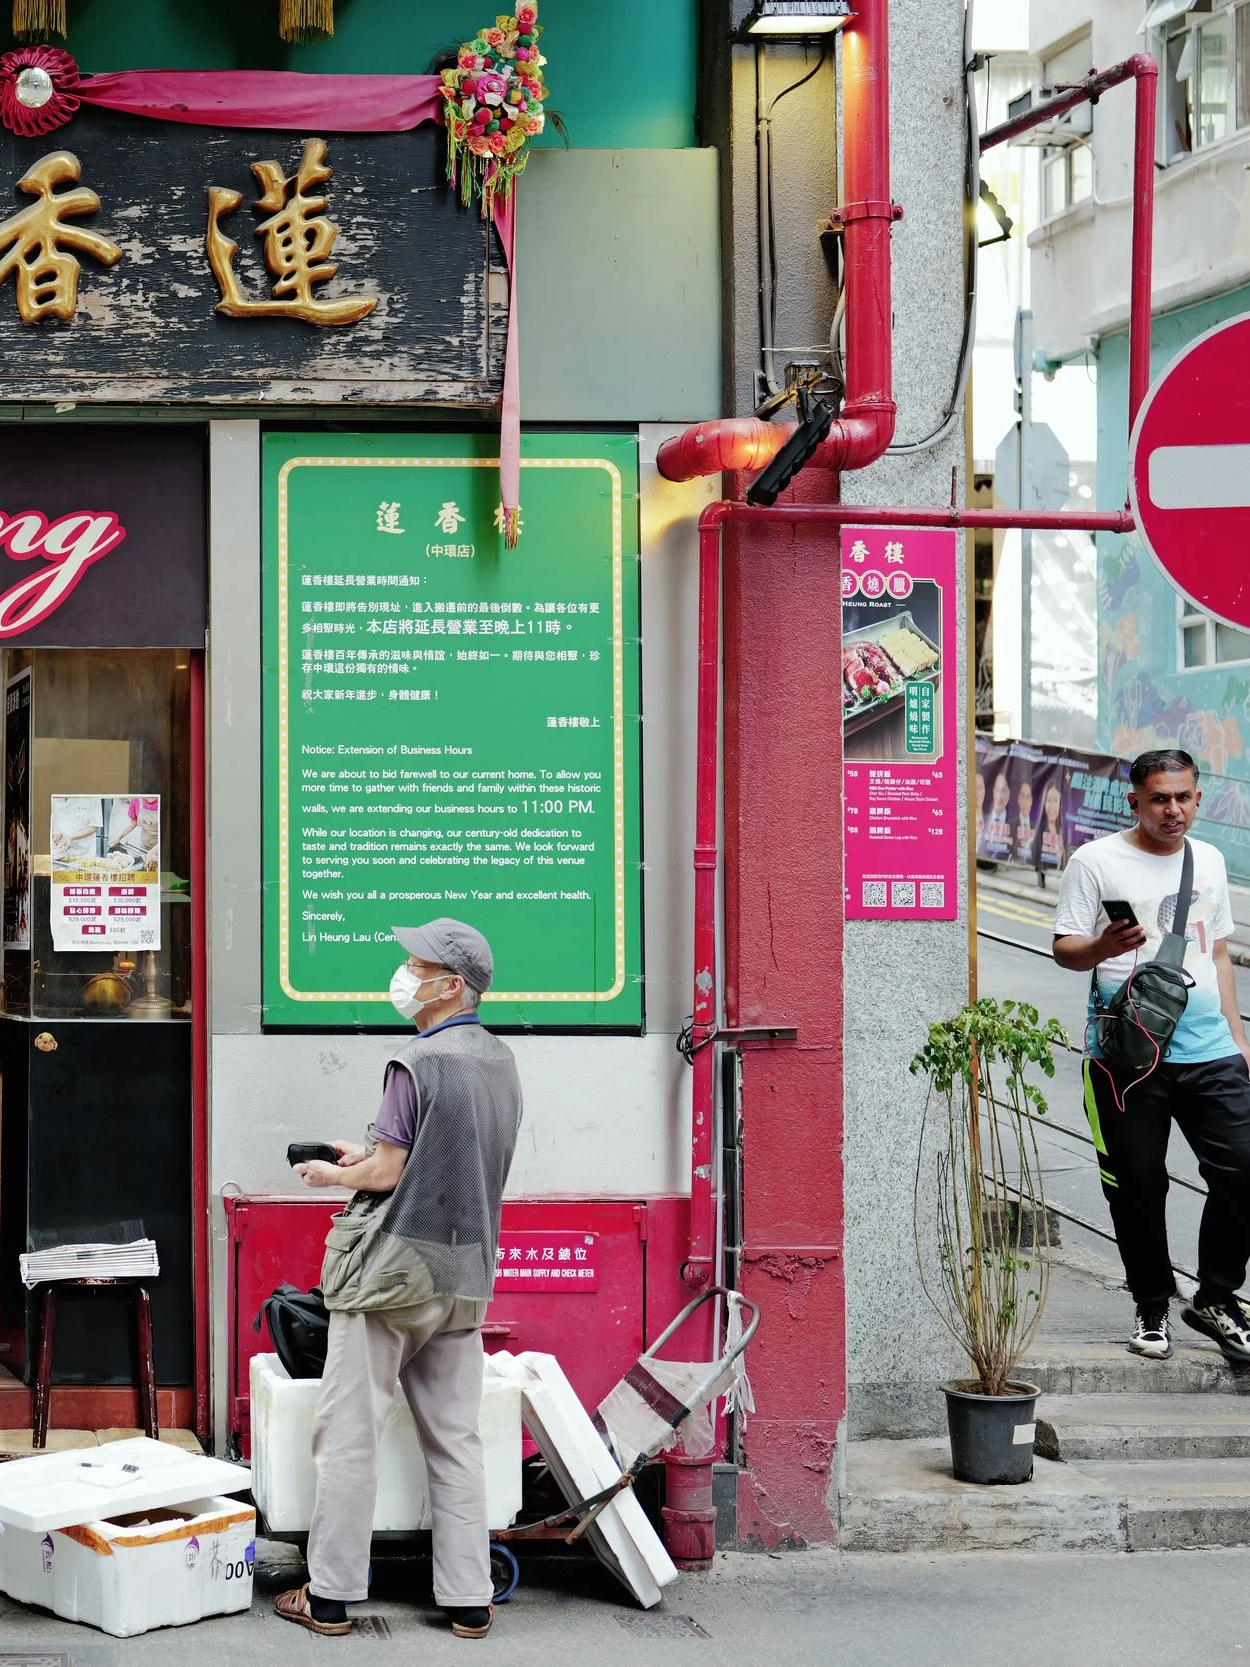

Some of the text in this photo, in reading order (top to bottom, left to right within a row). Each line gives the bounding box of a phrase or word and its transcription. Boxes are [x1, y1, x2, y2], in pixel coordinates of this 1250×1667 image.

[546, 716, 600, 728] 蓮香樓敬上
[301, 744, 473, 755] Notice: Extension of Business Hours
[301, 768, 602, 781] We are about to bid farewell to our current home. To allow you
[301, 782, 602, 794] more time to gather with friends and family within these historic
[301, 799, 595, 815] walls, we are extending our business hours to 11:00 PM.
[301, 827, 582, 839] While our location is changing, our century-old dedication to
[301, 841, 595, 853] taste and tradition remains exactly the same. We look forward
[301, 854, 586, 867] to serving you soon and celebrating the legacy of this venue
[301, 868, 344, 880] together.
[301, 889, 592, 901] We wish you all a prosperous New Year and excellent health.
[302, 910, 345, 922] Sincerely,
[302, 931, 398, 943] Lin Heung Lau (Cen
[503, 1268, 595, 1278] WATER MAIN SUPPLY AND CHECK METER
